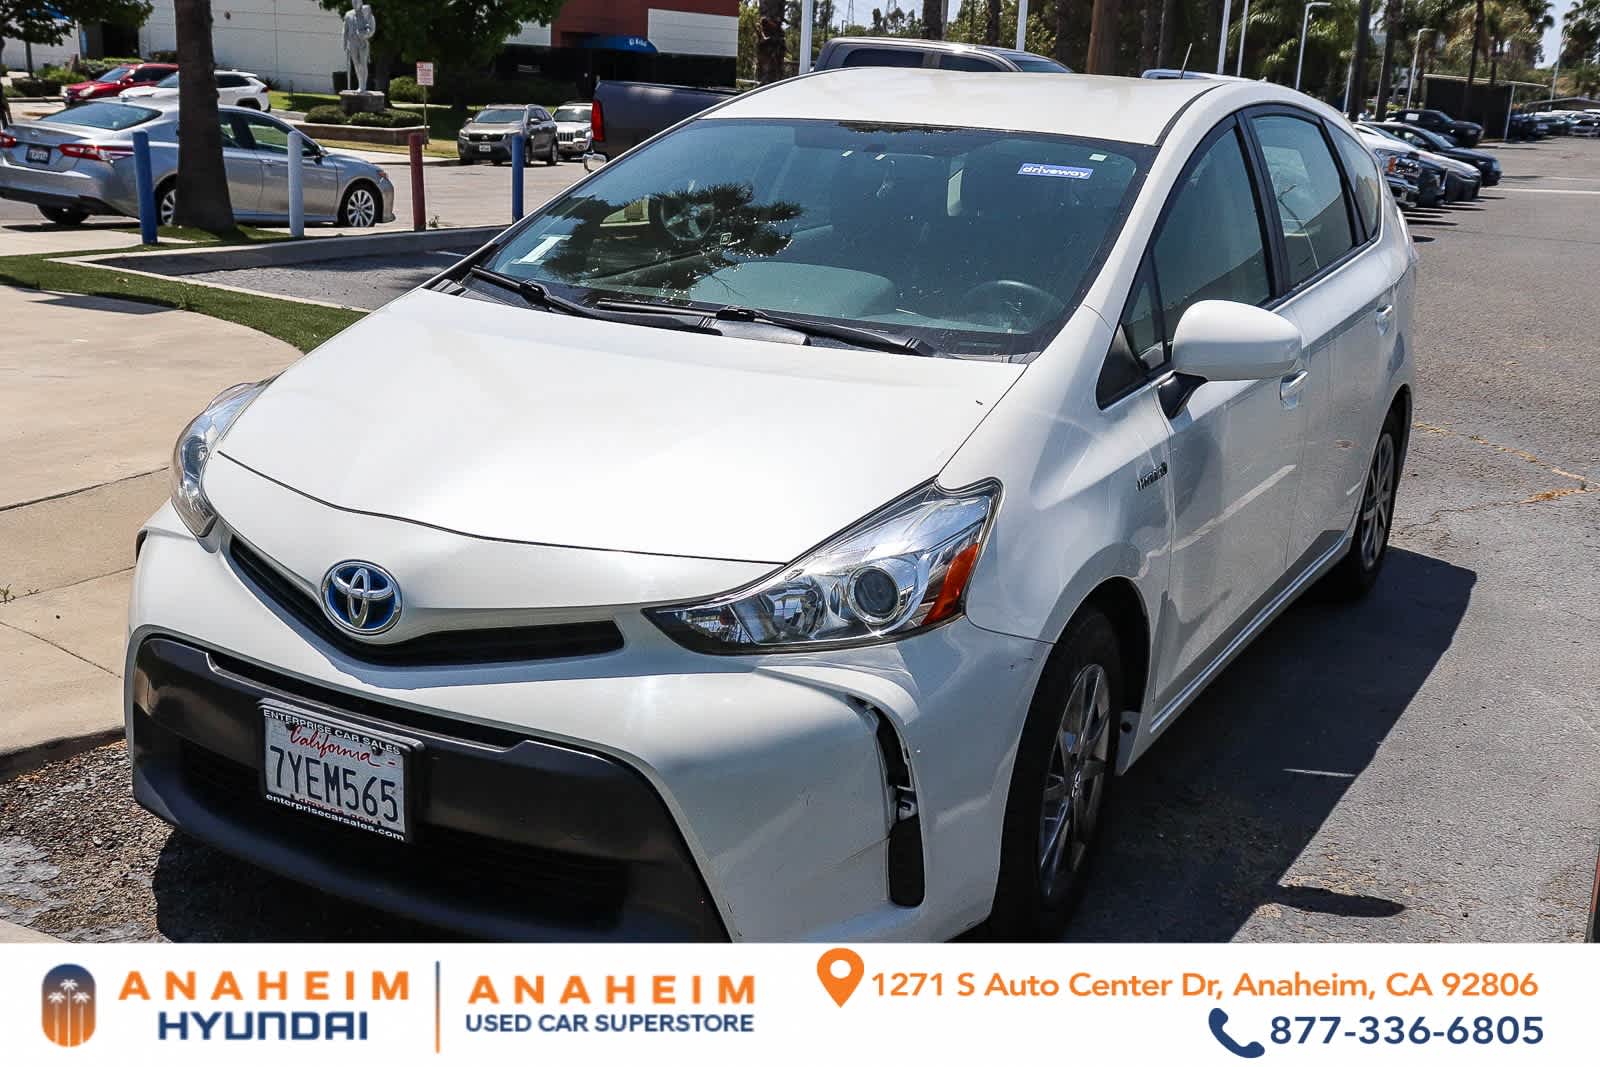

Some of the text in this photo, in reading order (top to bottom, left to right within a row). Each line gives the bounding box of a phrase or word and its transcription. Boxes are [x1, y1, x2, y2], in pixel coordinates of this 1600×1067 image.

[1022, 164, 1089, 179] driveway
[263, 708, 401, 756] ENTERPRISE CAR SALES
[290, 725, 381, 768] California
[269, 745, 399, 824] 7YEM565
[265, 794, 405, 842] enterprisecarsales.com
